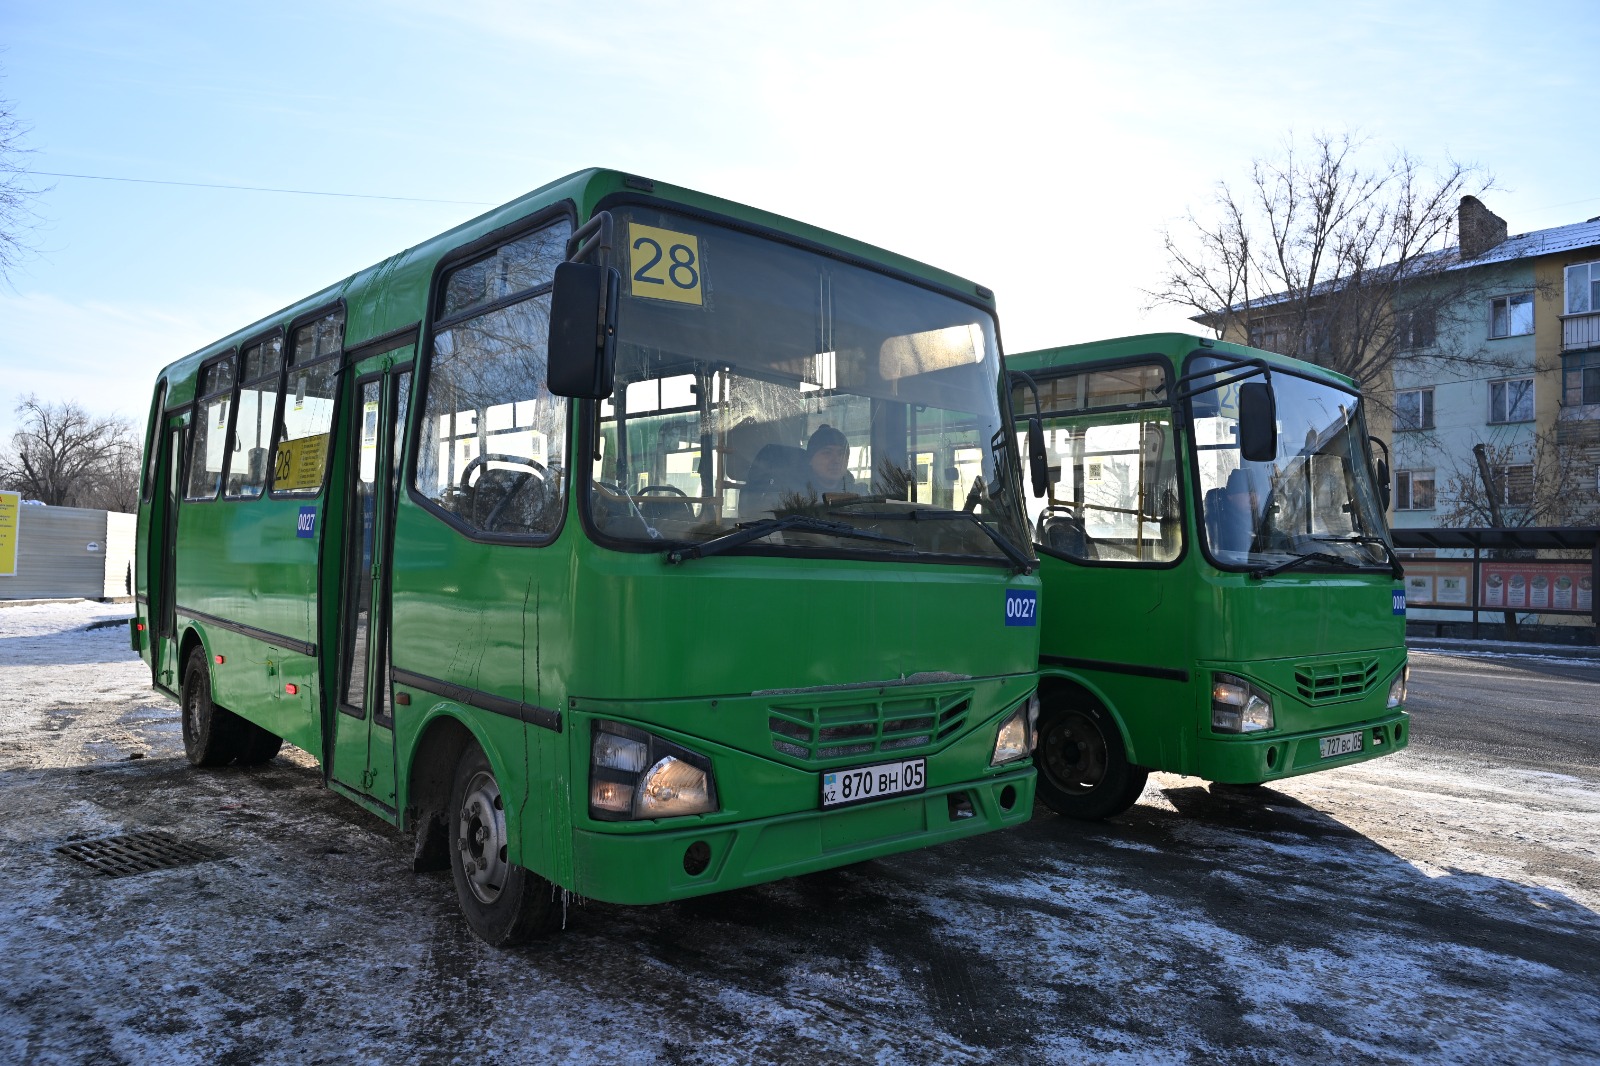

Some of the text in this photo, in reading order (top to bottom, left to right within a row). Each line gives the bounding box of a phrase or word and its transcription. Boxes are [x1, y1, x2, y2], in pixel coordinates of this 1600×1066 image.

[633, 237, 699, 290] 28
[275, 449, 291, 481] 28
[298, 514, 316, 531] 0027
[1006, 597, 1036, 618] 0027
[1327, 738, 1340, 755] 727
[1341, 740, 1351, 752] BC
[1353, 734, 1362, 750] 05
[842, 763, 924, 798] 870 BH 05
[824, 791, 836, 802] KZ
